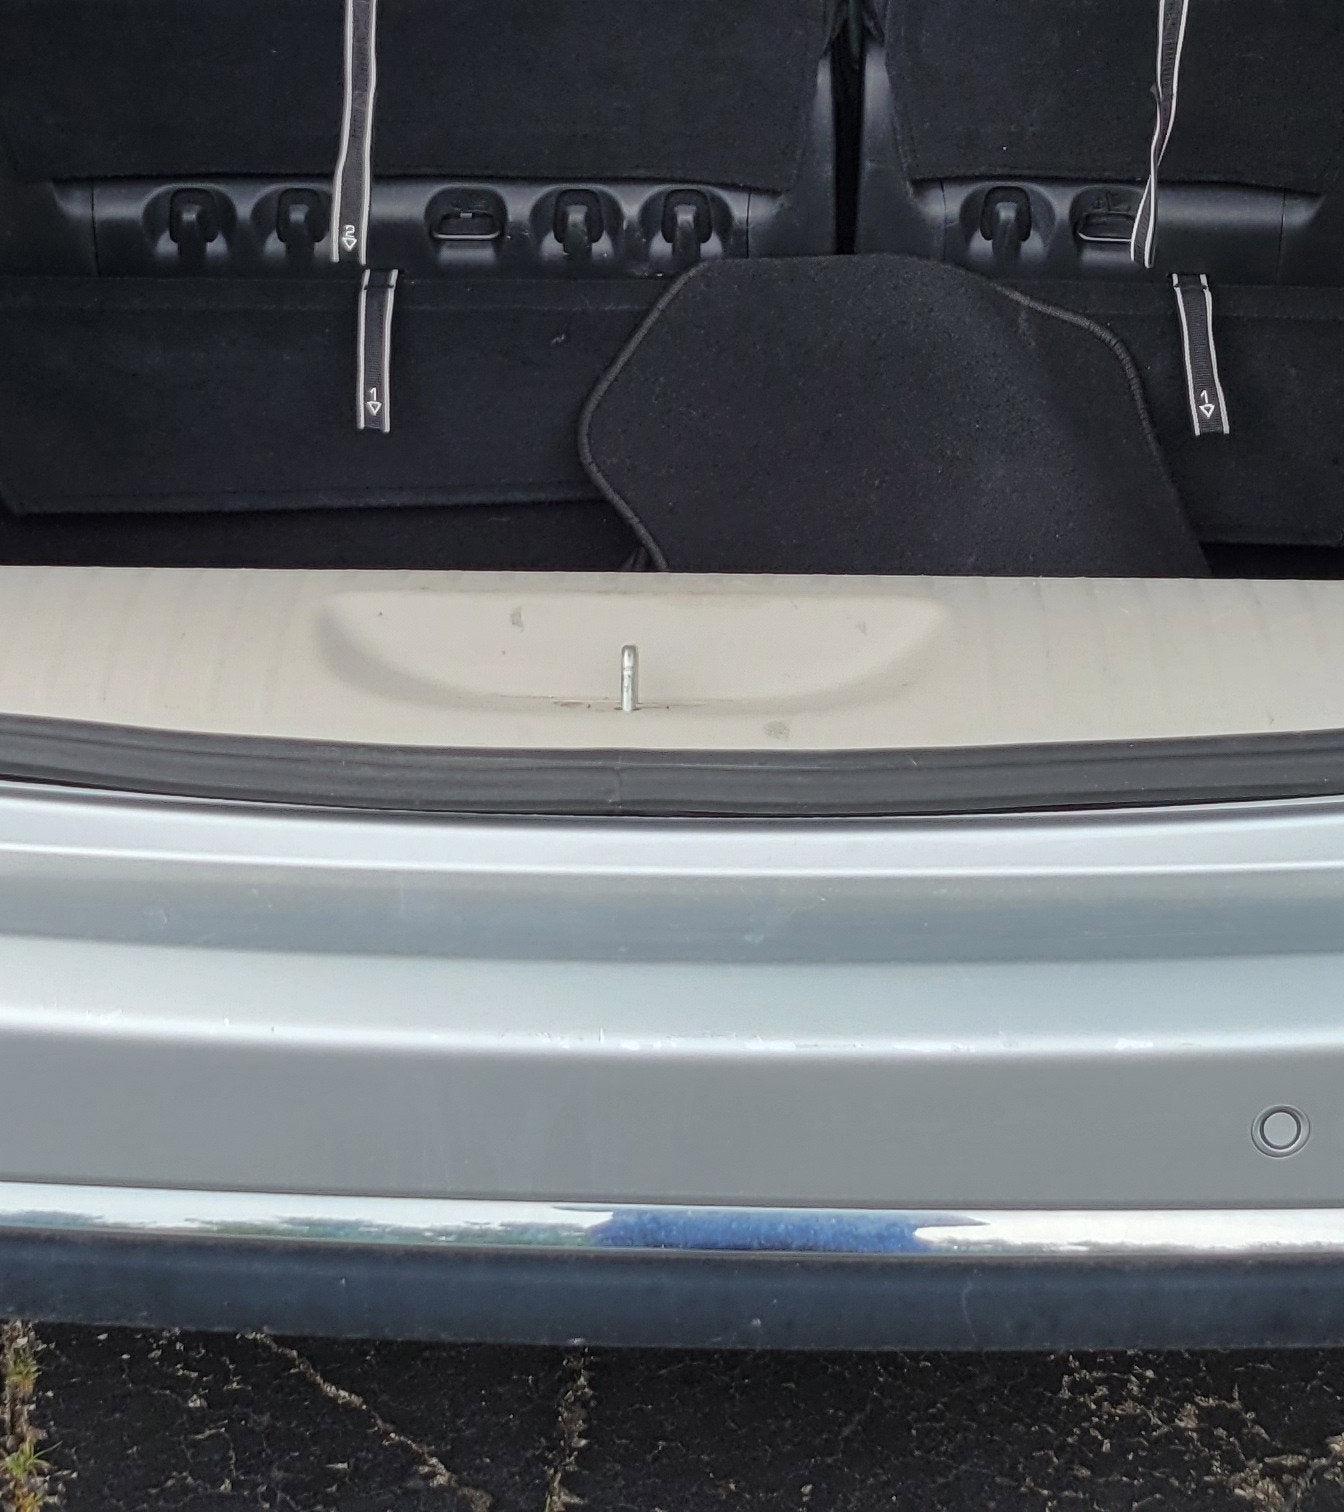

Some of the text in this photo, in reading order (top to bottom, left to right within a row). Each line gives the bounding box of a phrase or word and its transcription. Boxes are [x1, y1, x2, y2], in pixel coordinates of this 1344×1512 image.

[345, 224, 355, 238] 2
[369, 387, 377, 401] 1
[1200, 389, 1209, 404] 1
